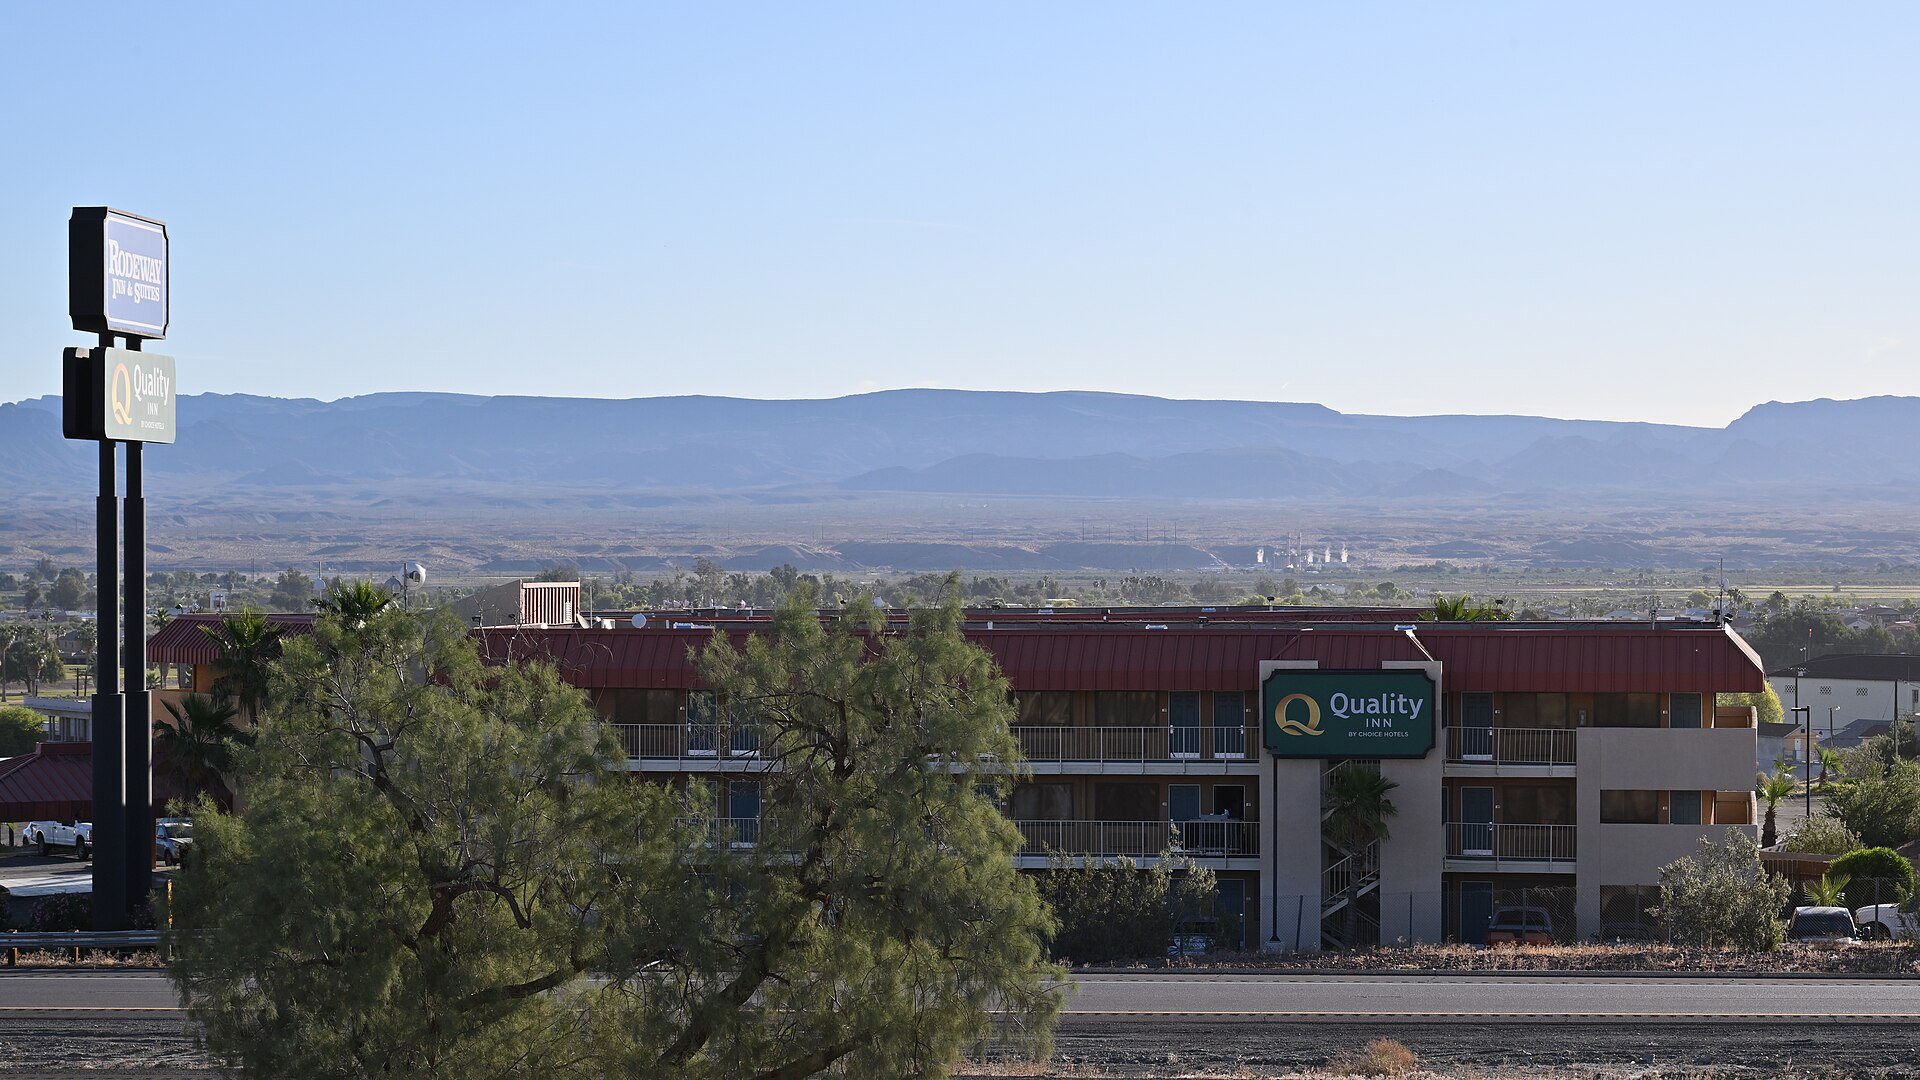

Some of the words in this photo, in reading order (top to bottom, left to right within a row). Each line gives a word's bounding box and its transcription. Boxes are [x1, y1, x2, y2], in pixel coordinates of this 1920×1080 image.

[127, 281, 133, 296] &
[133, 364, 170, 406] Quality
[147, 402, 159, 415] INN
[1275, 693, 1325, 736] Q
[1330, 692, 1424, 720] Quality
[1366, 718, 1392, 728] INN
